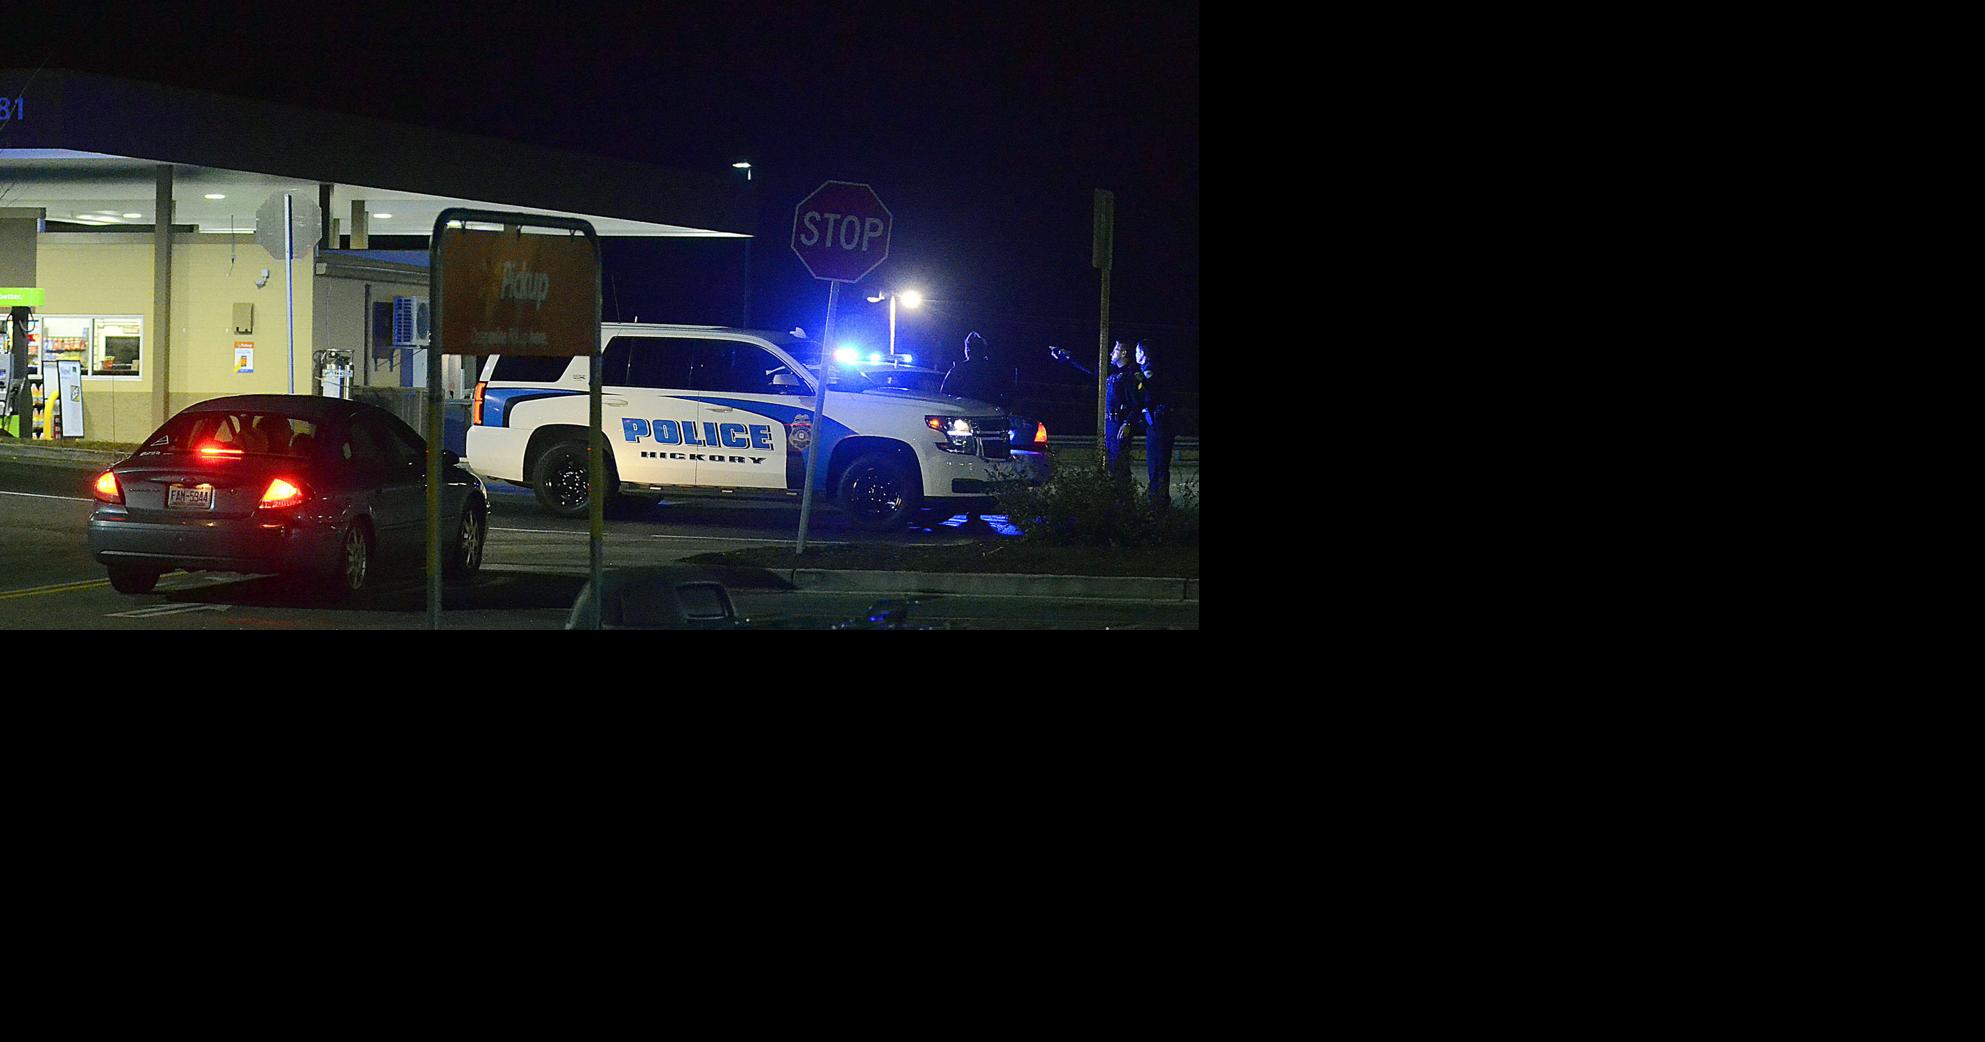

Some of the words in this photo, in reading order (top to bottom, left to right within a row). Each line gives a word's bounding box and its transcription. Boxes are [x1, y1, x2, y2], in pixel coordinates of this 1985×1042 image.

[800, 210, 885, 252] STOP
[502, 260, 550, 311] Pickup
[621, 417, 775, 450] POLICE
[640, 451, 767, 465] HICKORY
